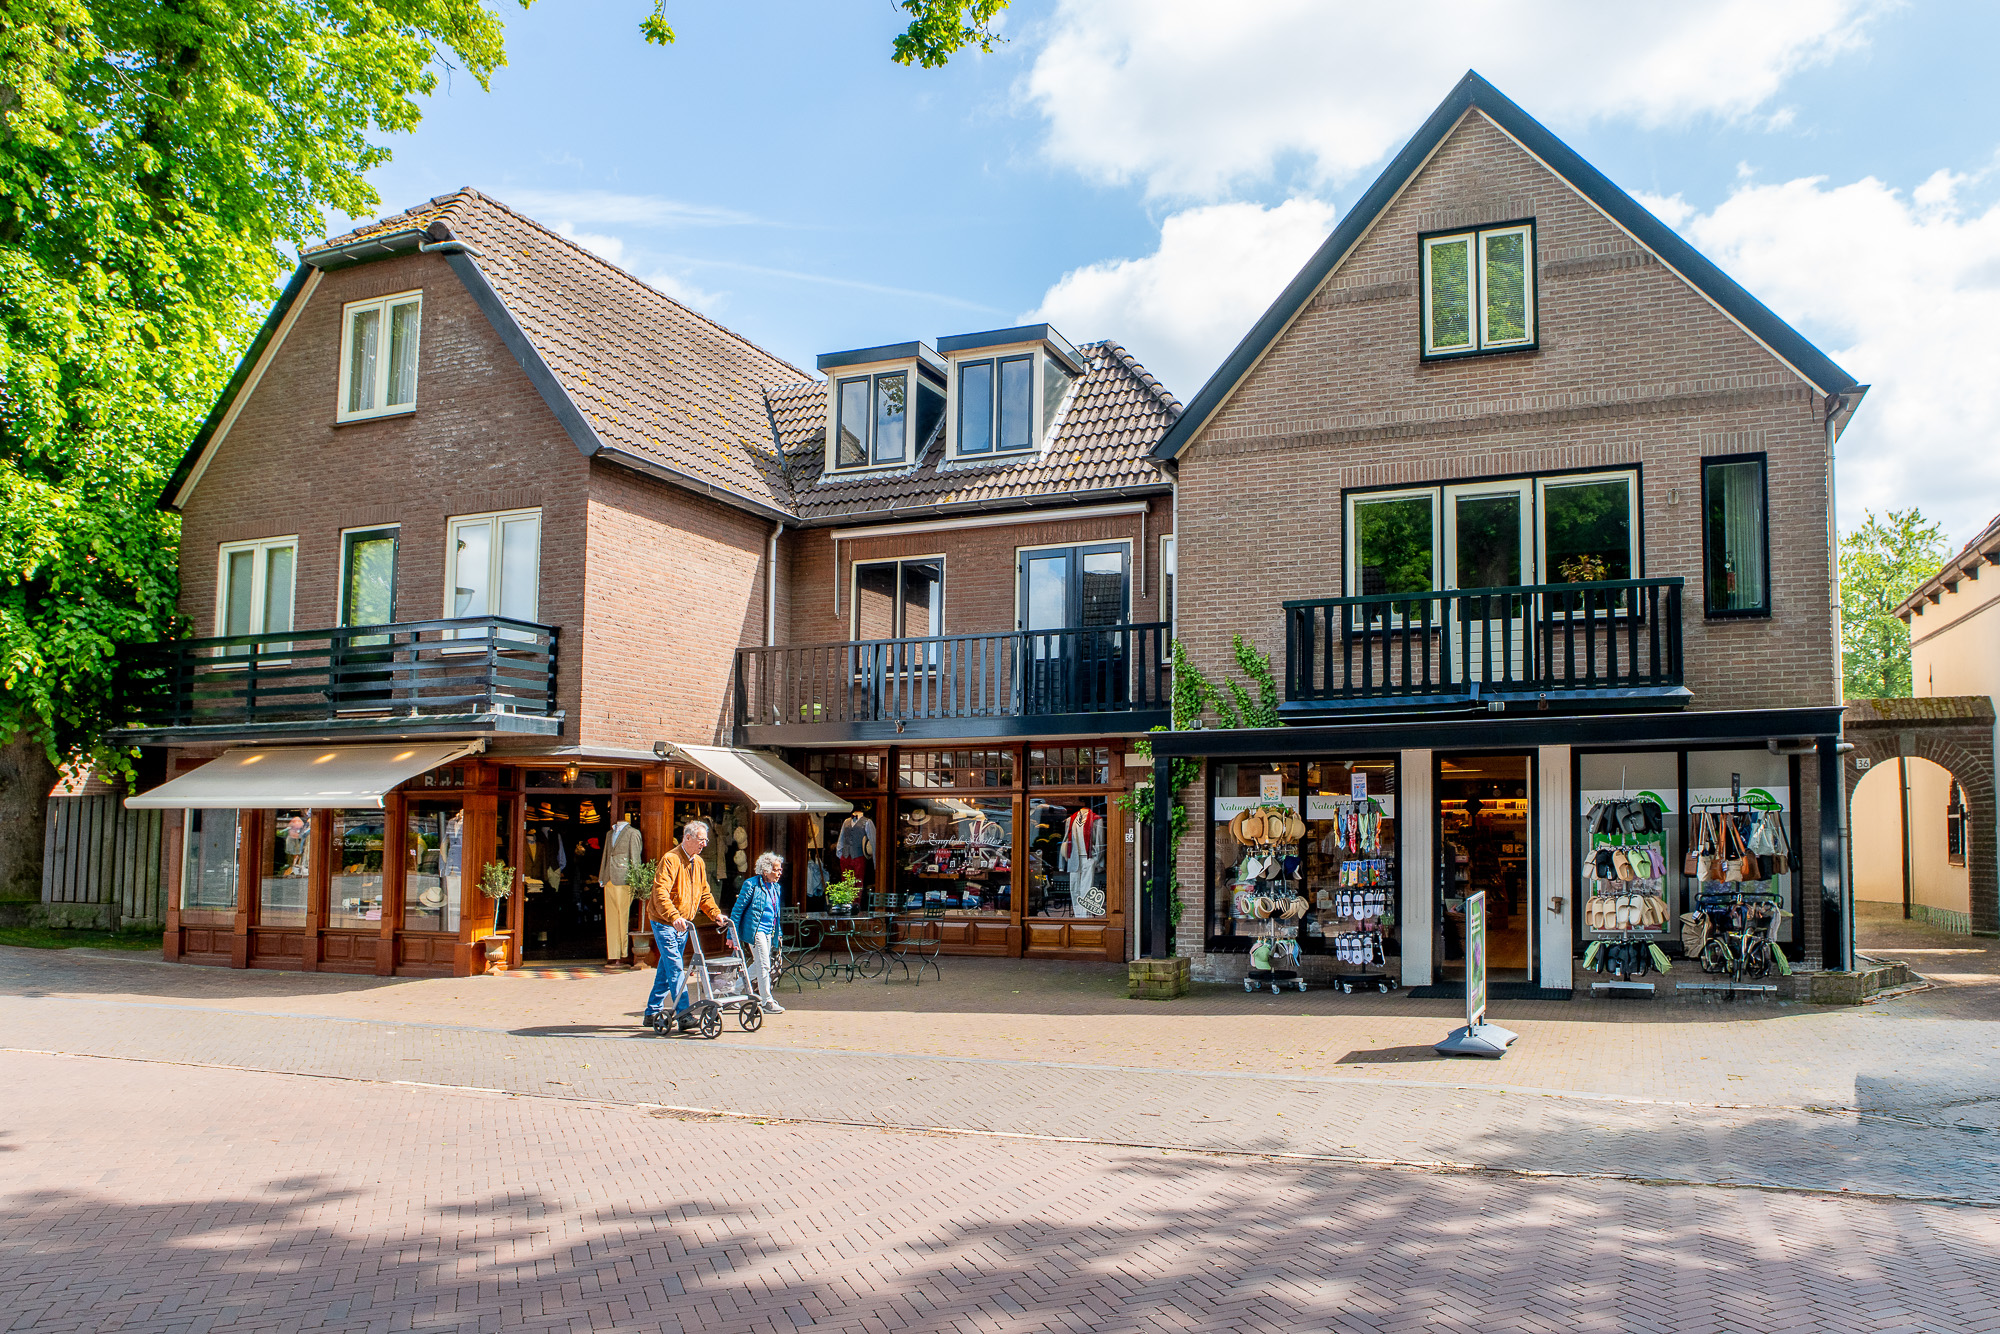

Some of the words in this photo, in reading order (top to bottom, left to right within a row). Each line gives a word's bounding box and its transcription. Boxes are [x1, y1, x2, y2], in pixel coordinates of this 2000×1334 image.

[1857, 759, 1869, 768] 36
[905, 832, 926, 845] The
[927, 832, 964, 848] English
[1089, 889, 1103, 903] 90
[1078, 898, 1102, 914] HATTER
